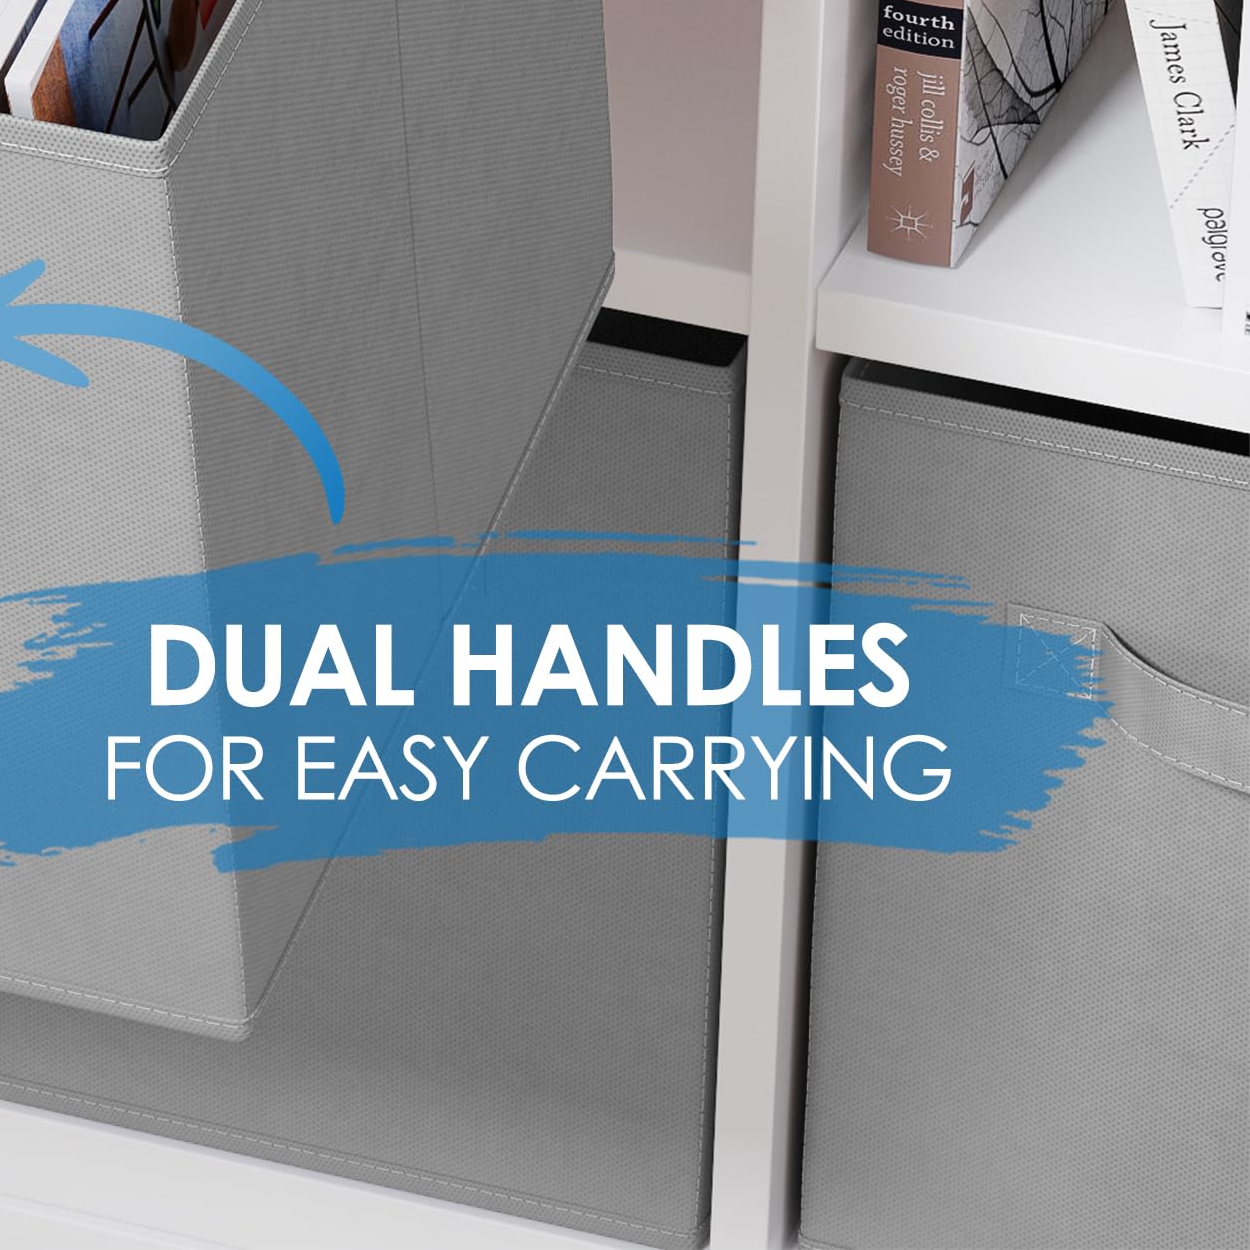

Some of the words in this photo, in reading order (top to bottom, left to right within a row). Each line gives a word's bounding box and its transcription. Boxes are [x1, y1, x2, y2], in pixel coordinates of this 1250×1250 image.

[883, 5, 955, 30] fourth
[882, 26, 955, 50] edition
[886, 66, 908, 114] roger
[917, 71, 945, 98] jill
[1149, 19, 1188, 84] James
[1174, 92, 1210, 150] Clark
[919, 100, 944, 143] collis
[884, 116, 913, 177] hussey
[918, 145, 940, 162] &
